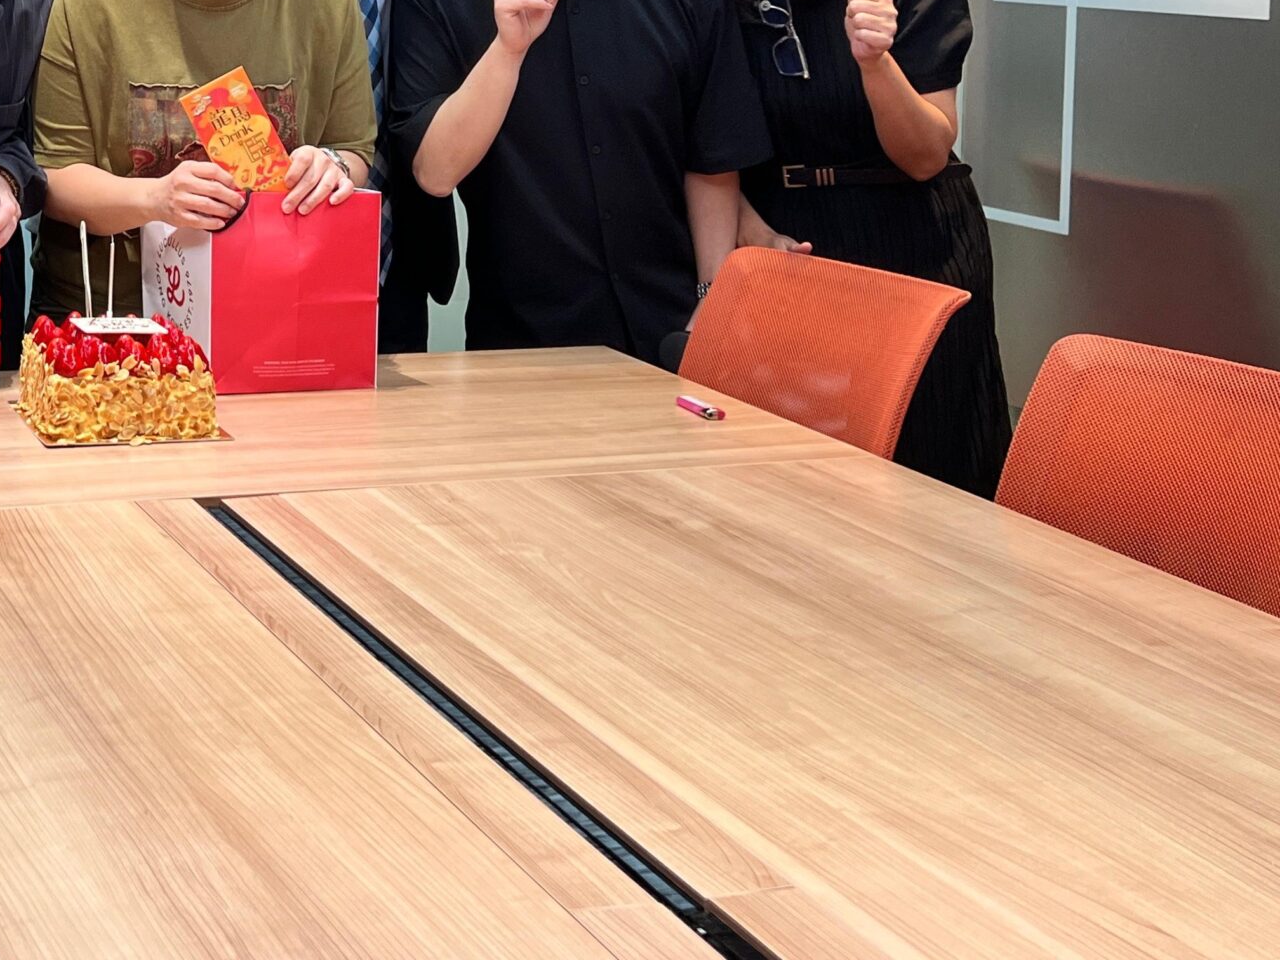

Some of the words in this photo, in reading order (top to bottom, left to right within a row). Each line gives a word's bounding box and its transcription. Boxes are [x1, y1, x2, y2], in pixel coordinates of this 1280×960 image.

[209, 106, 252, 131] 龍馬
[219, 125, 254, 147] Drink
[157, 237, 186, 266] LUCULLUS
